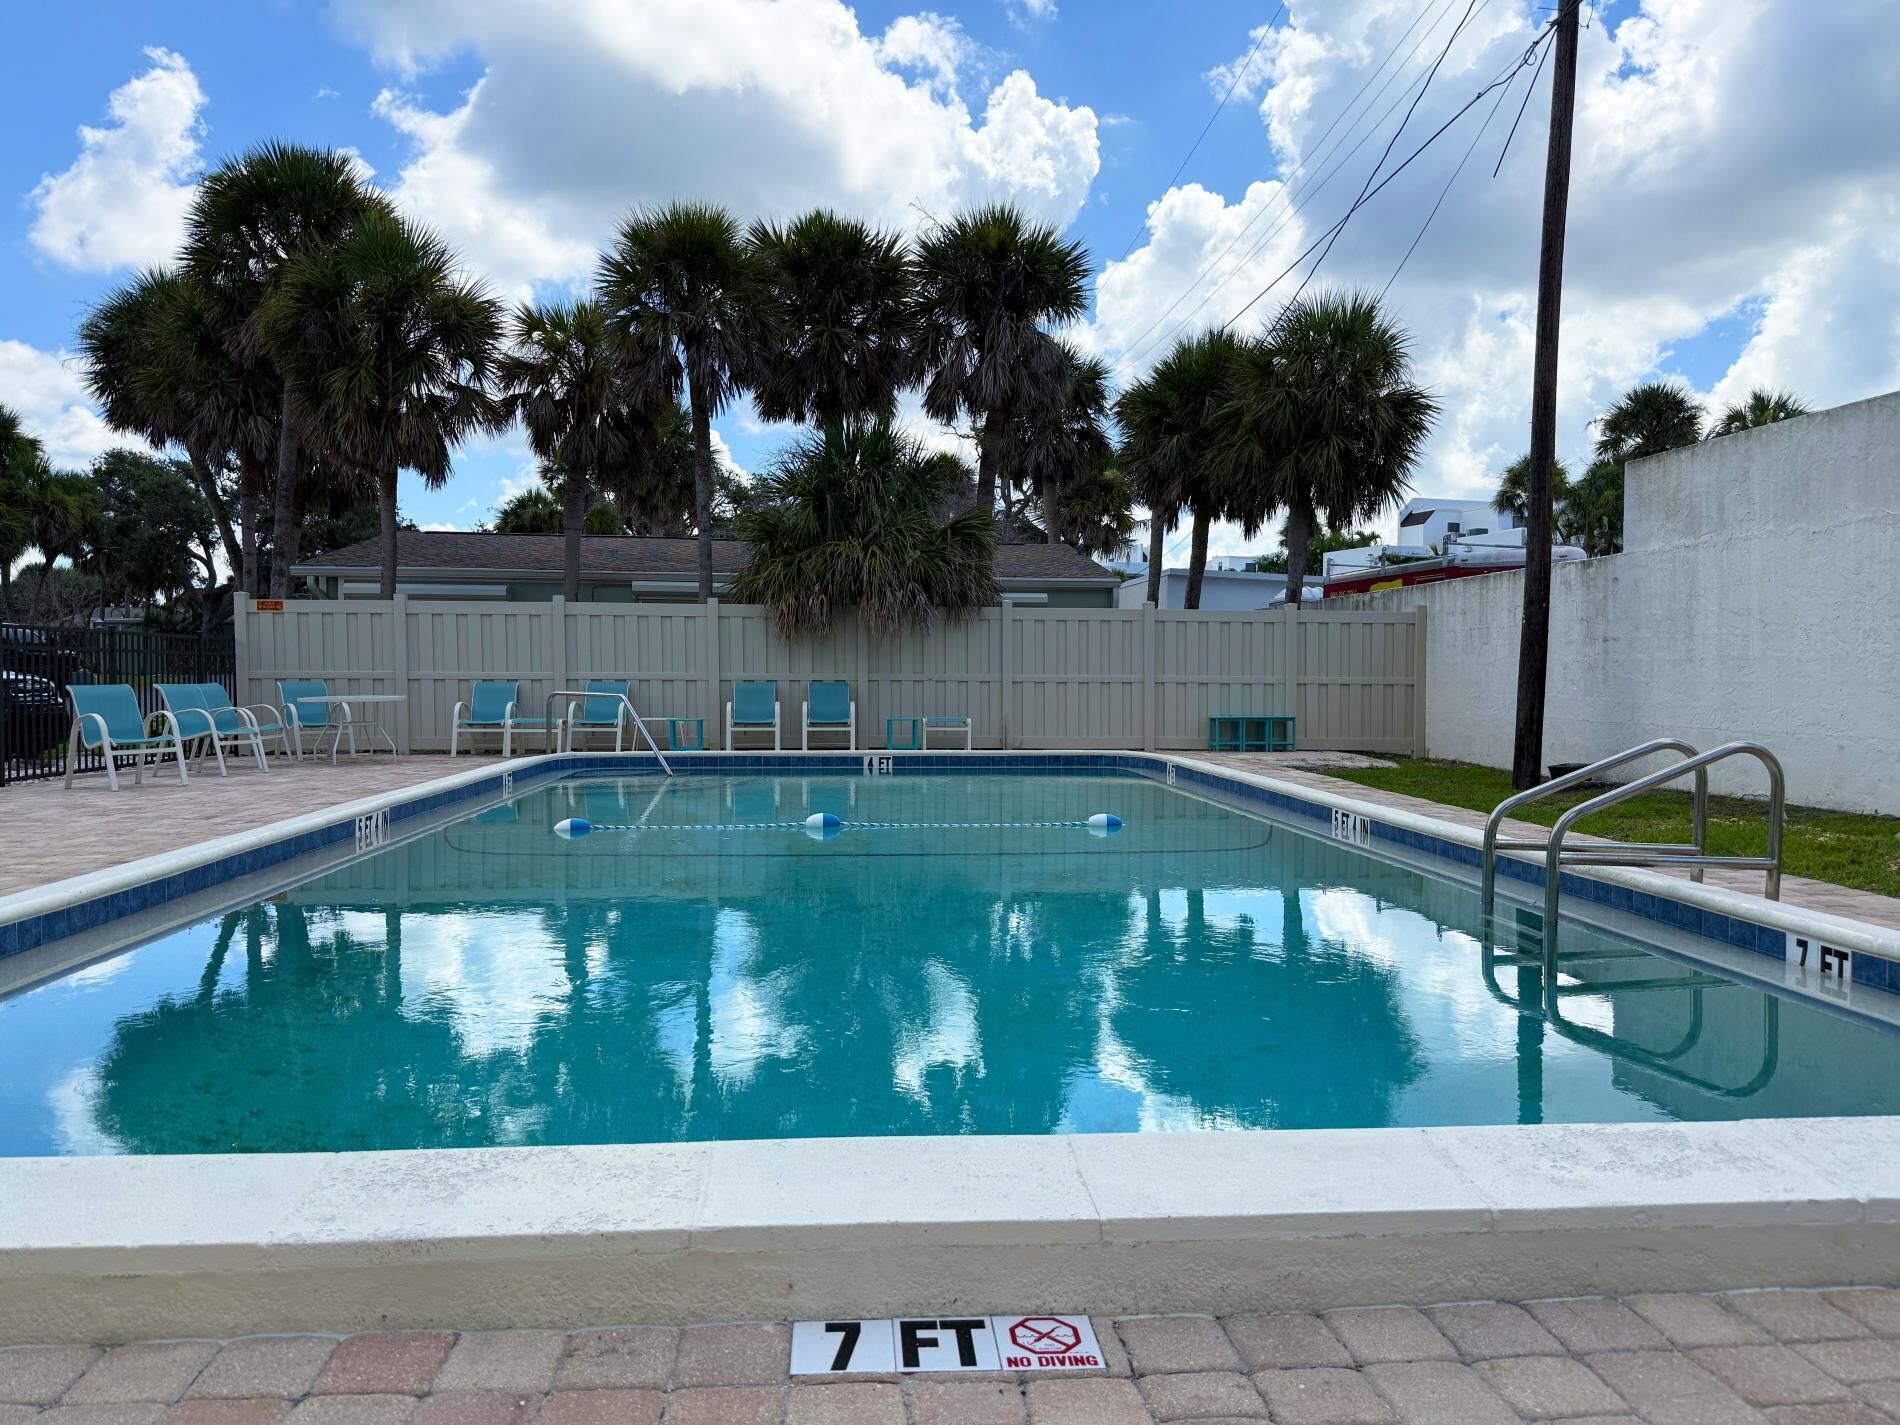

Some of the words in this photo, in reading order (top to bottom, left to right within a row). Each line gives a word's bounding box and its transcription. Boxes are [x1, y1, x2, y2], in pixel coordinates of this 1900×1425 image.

[867, 756, 873, 767] 4
[879, 756, 891, 768] FT
[365, 815, 373, 833] FT
[382, 809, 389, 828] IN
[1341, 811, 1350, 828] FT
[1352, 815, 1357, 831] 4
[1360, 817, 1369, 834] IN
[1796, 937, 1808, 967] 7
[1820, 944, 1849, 978] FT
[825, 1322, 861, 1371] 7
[900, 1319, 986, 1368] FT
[1006, 1355, 1032, 1368] NO
[1037, 1354, 1099, 1367] DIVING
